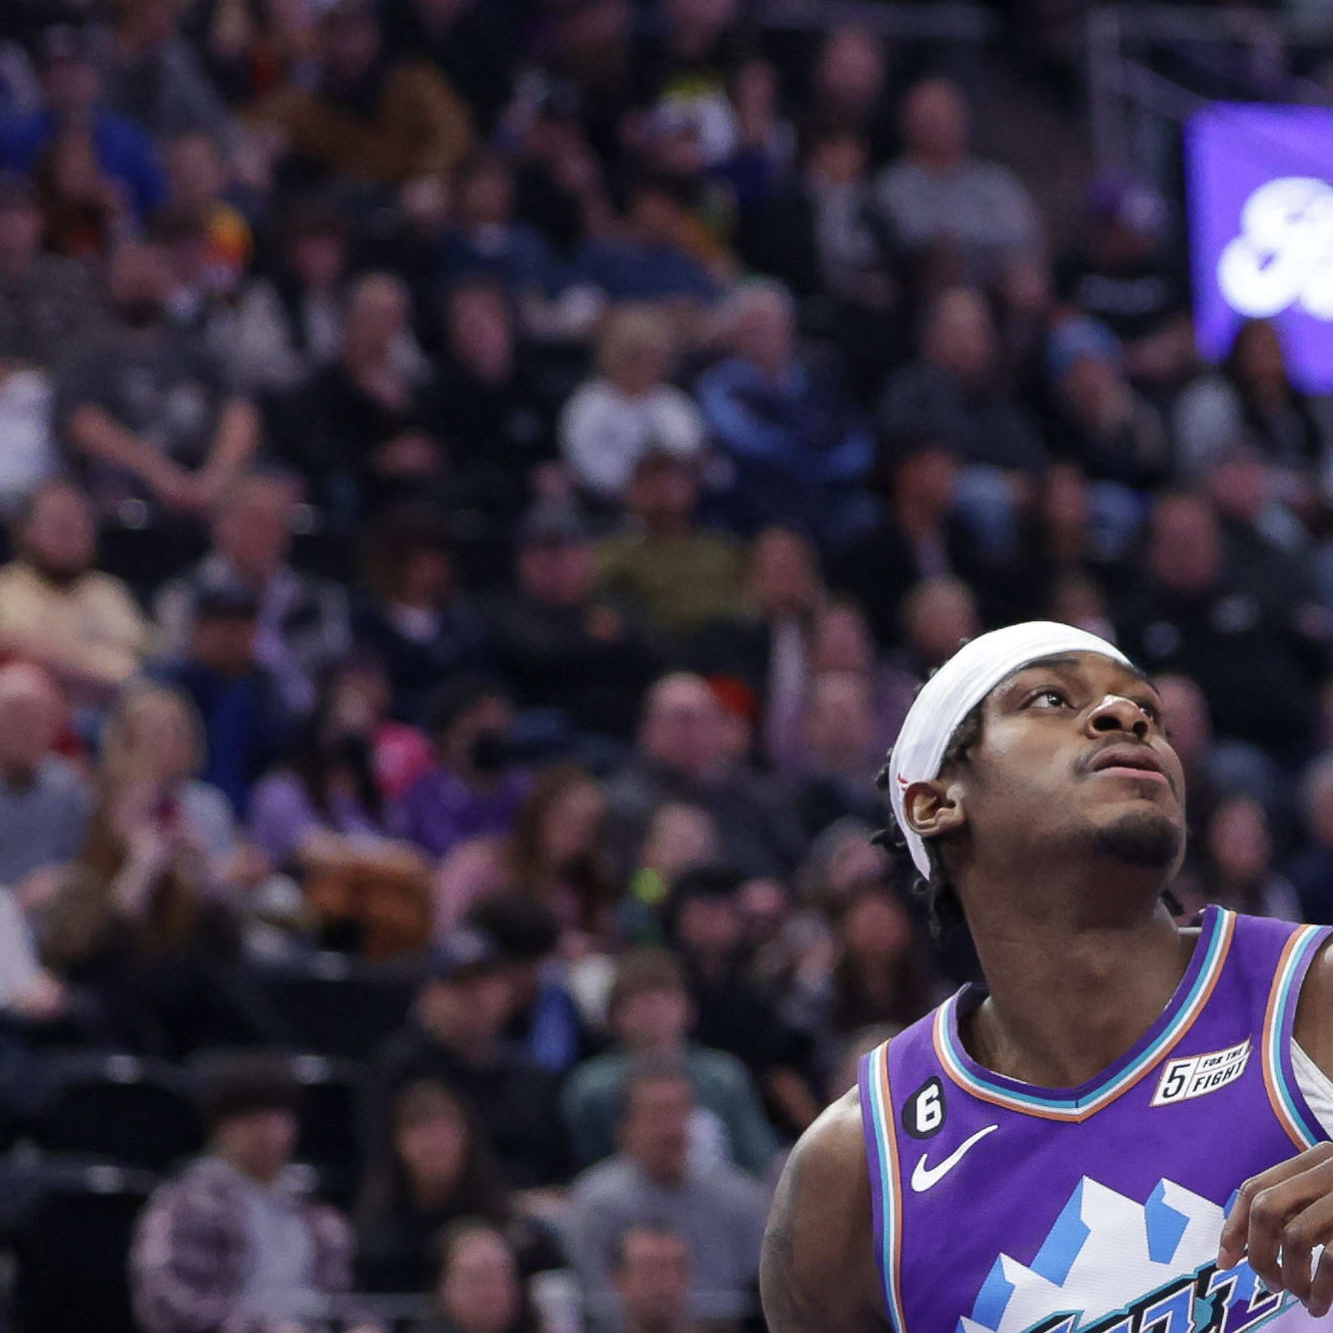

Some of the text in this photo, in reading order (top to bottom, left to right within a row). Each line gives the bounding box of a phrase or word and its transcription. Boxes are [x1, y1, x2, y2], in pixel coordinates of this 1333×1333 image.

[1162, 1063, 1192, 1099] 5
[1192, 1057, 1246, 1092] FIGHT
[916, 1083, 942, 1133] 6
